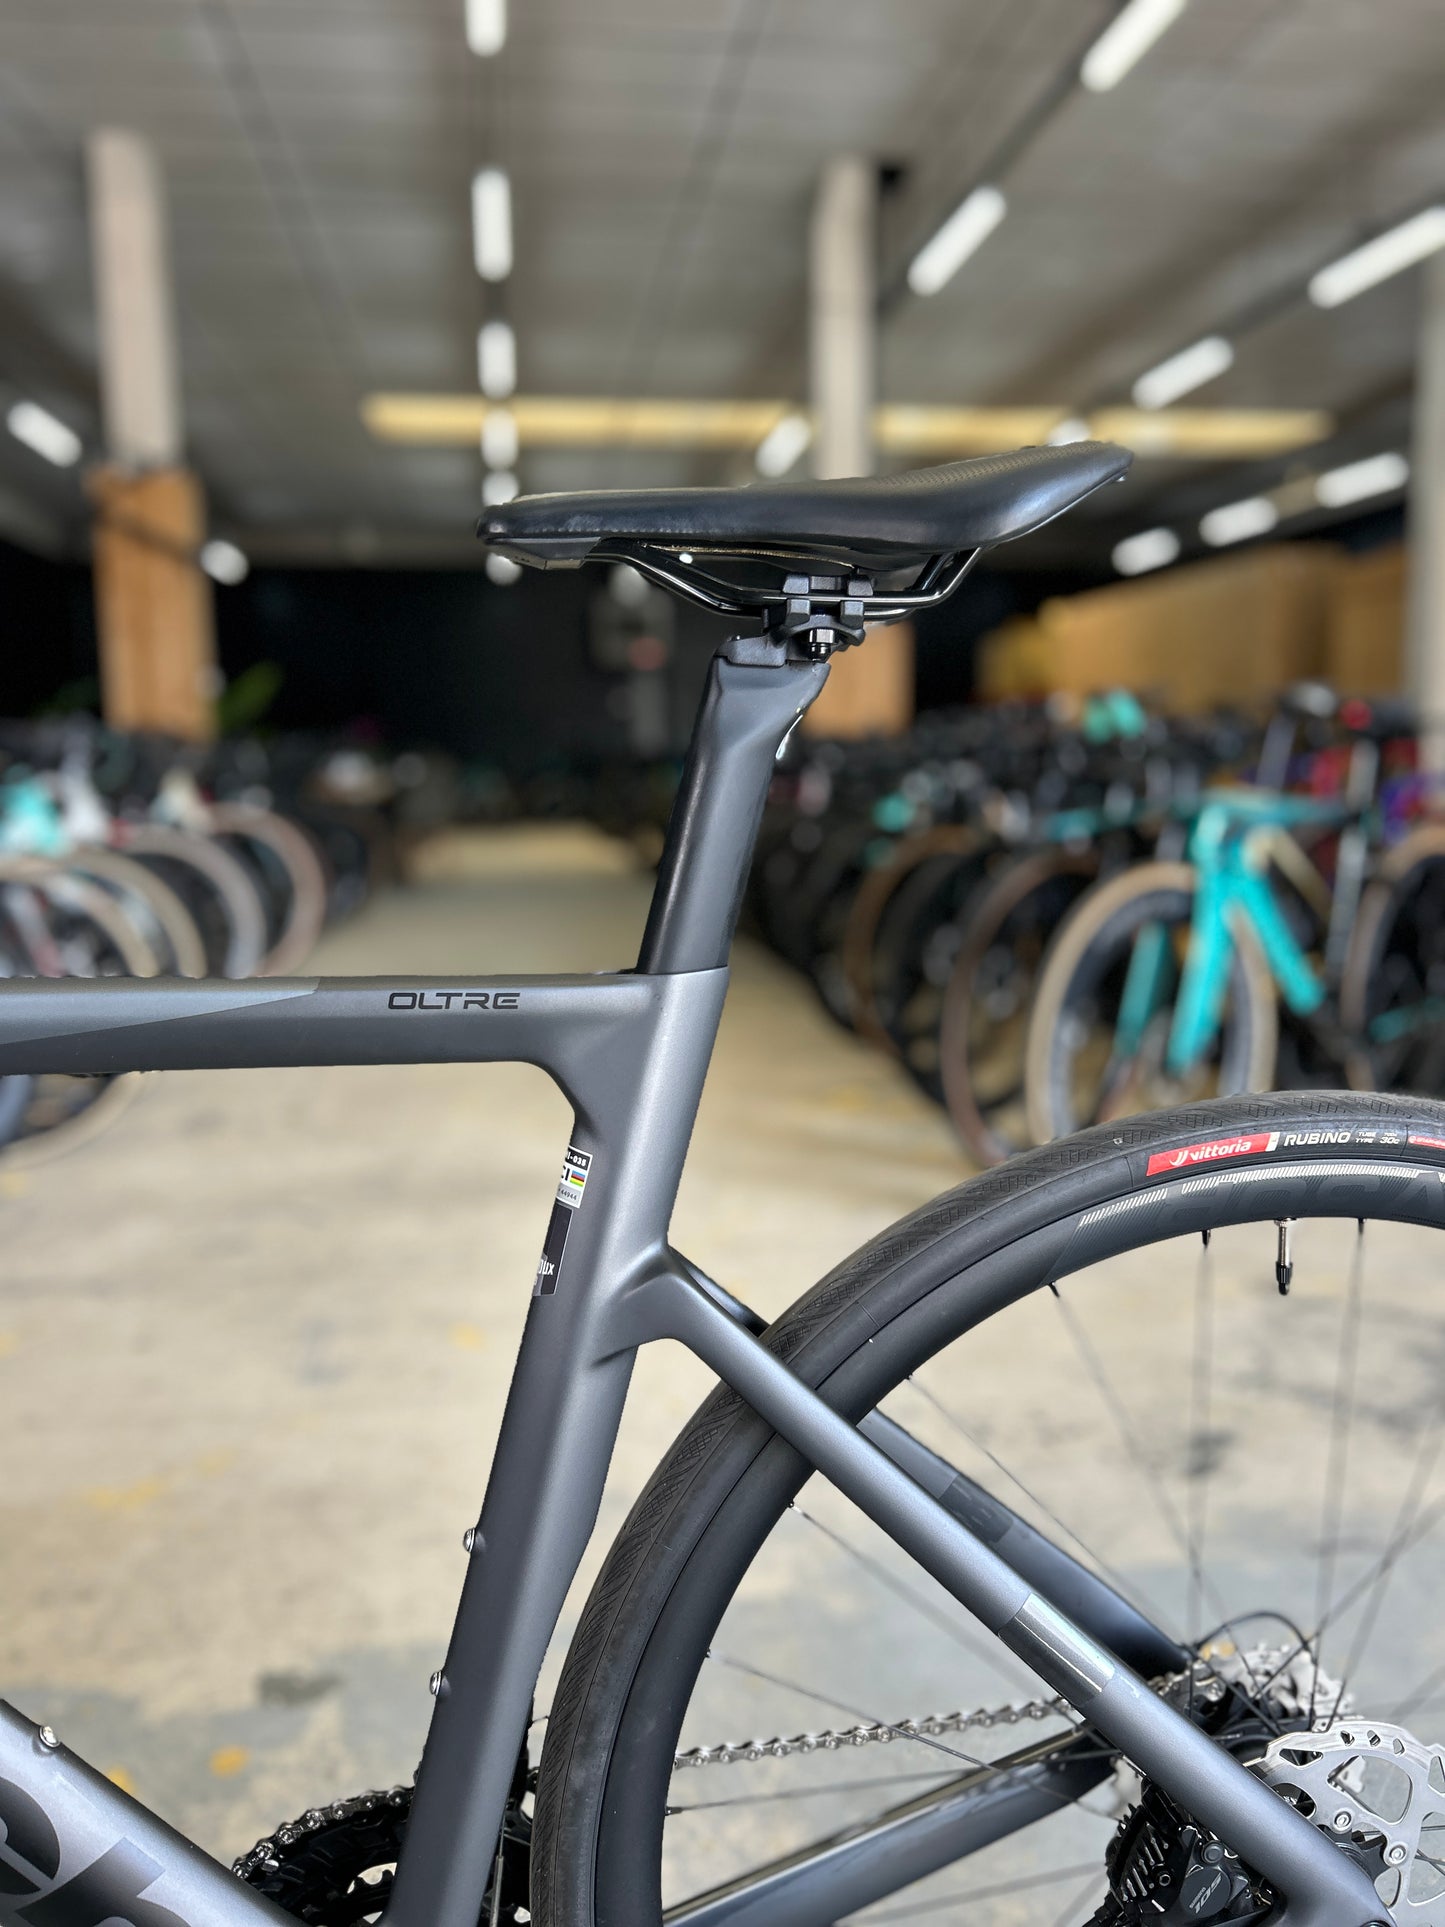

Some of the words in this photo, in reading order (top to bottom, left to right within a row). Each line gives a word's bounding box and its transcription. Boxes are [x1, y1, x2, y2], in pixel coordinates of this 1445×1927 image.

[388, 992, 521, 1010] OLTRE
[1283, 1131, 1350, 1147] RUBINO
[1189, 1140, 1252, 1161] vittoria
